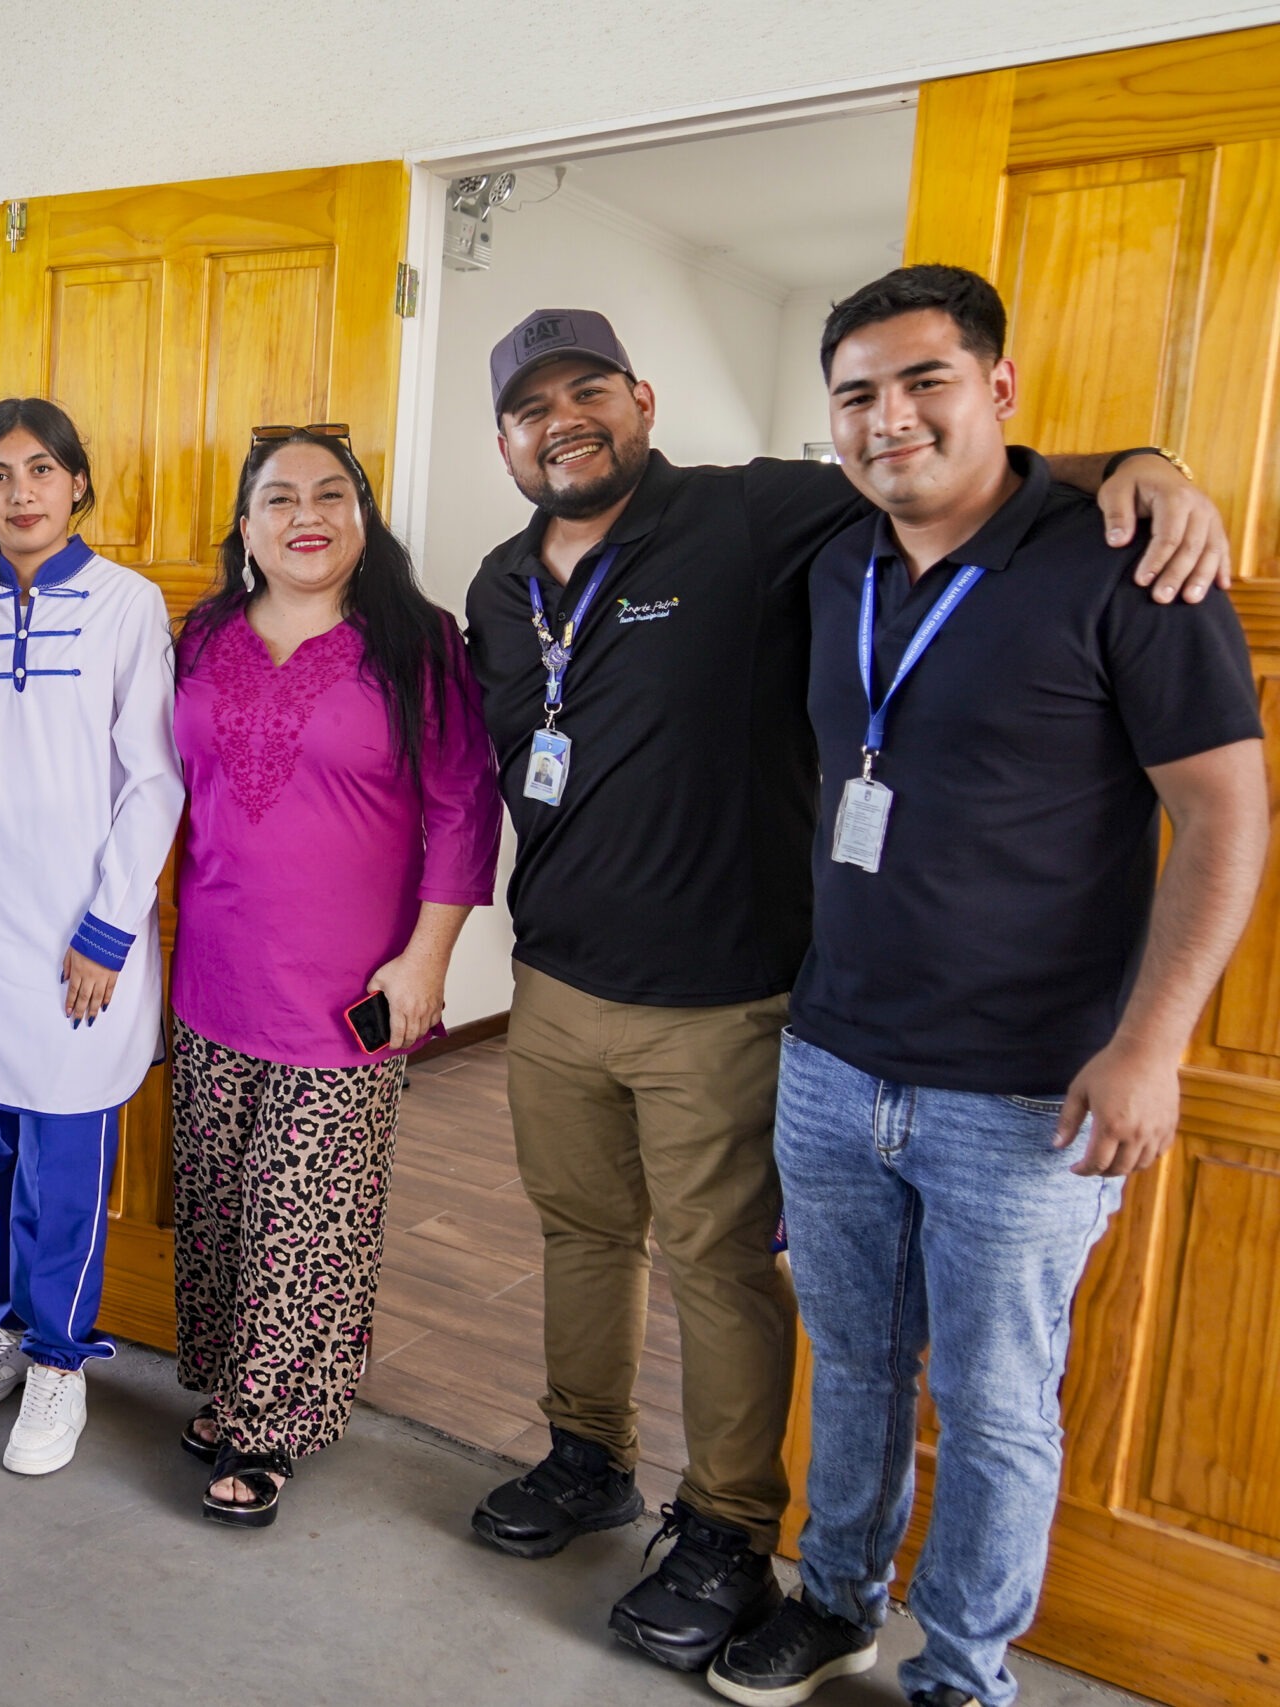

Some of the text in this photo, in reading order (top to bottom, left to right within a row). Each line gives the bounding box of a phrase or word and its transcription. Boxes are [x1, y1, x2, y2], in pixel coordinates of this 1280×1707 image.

[524, 319, 561, 348] CAT
[900, 621, 936, 671] MUNICIPALIDAD
[933, 609, 943, 621] DE
[940, 586, 962, 611] MONTE
[957, 565, 978, 588] PATRIA
